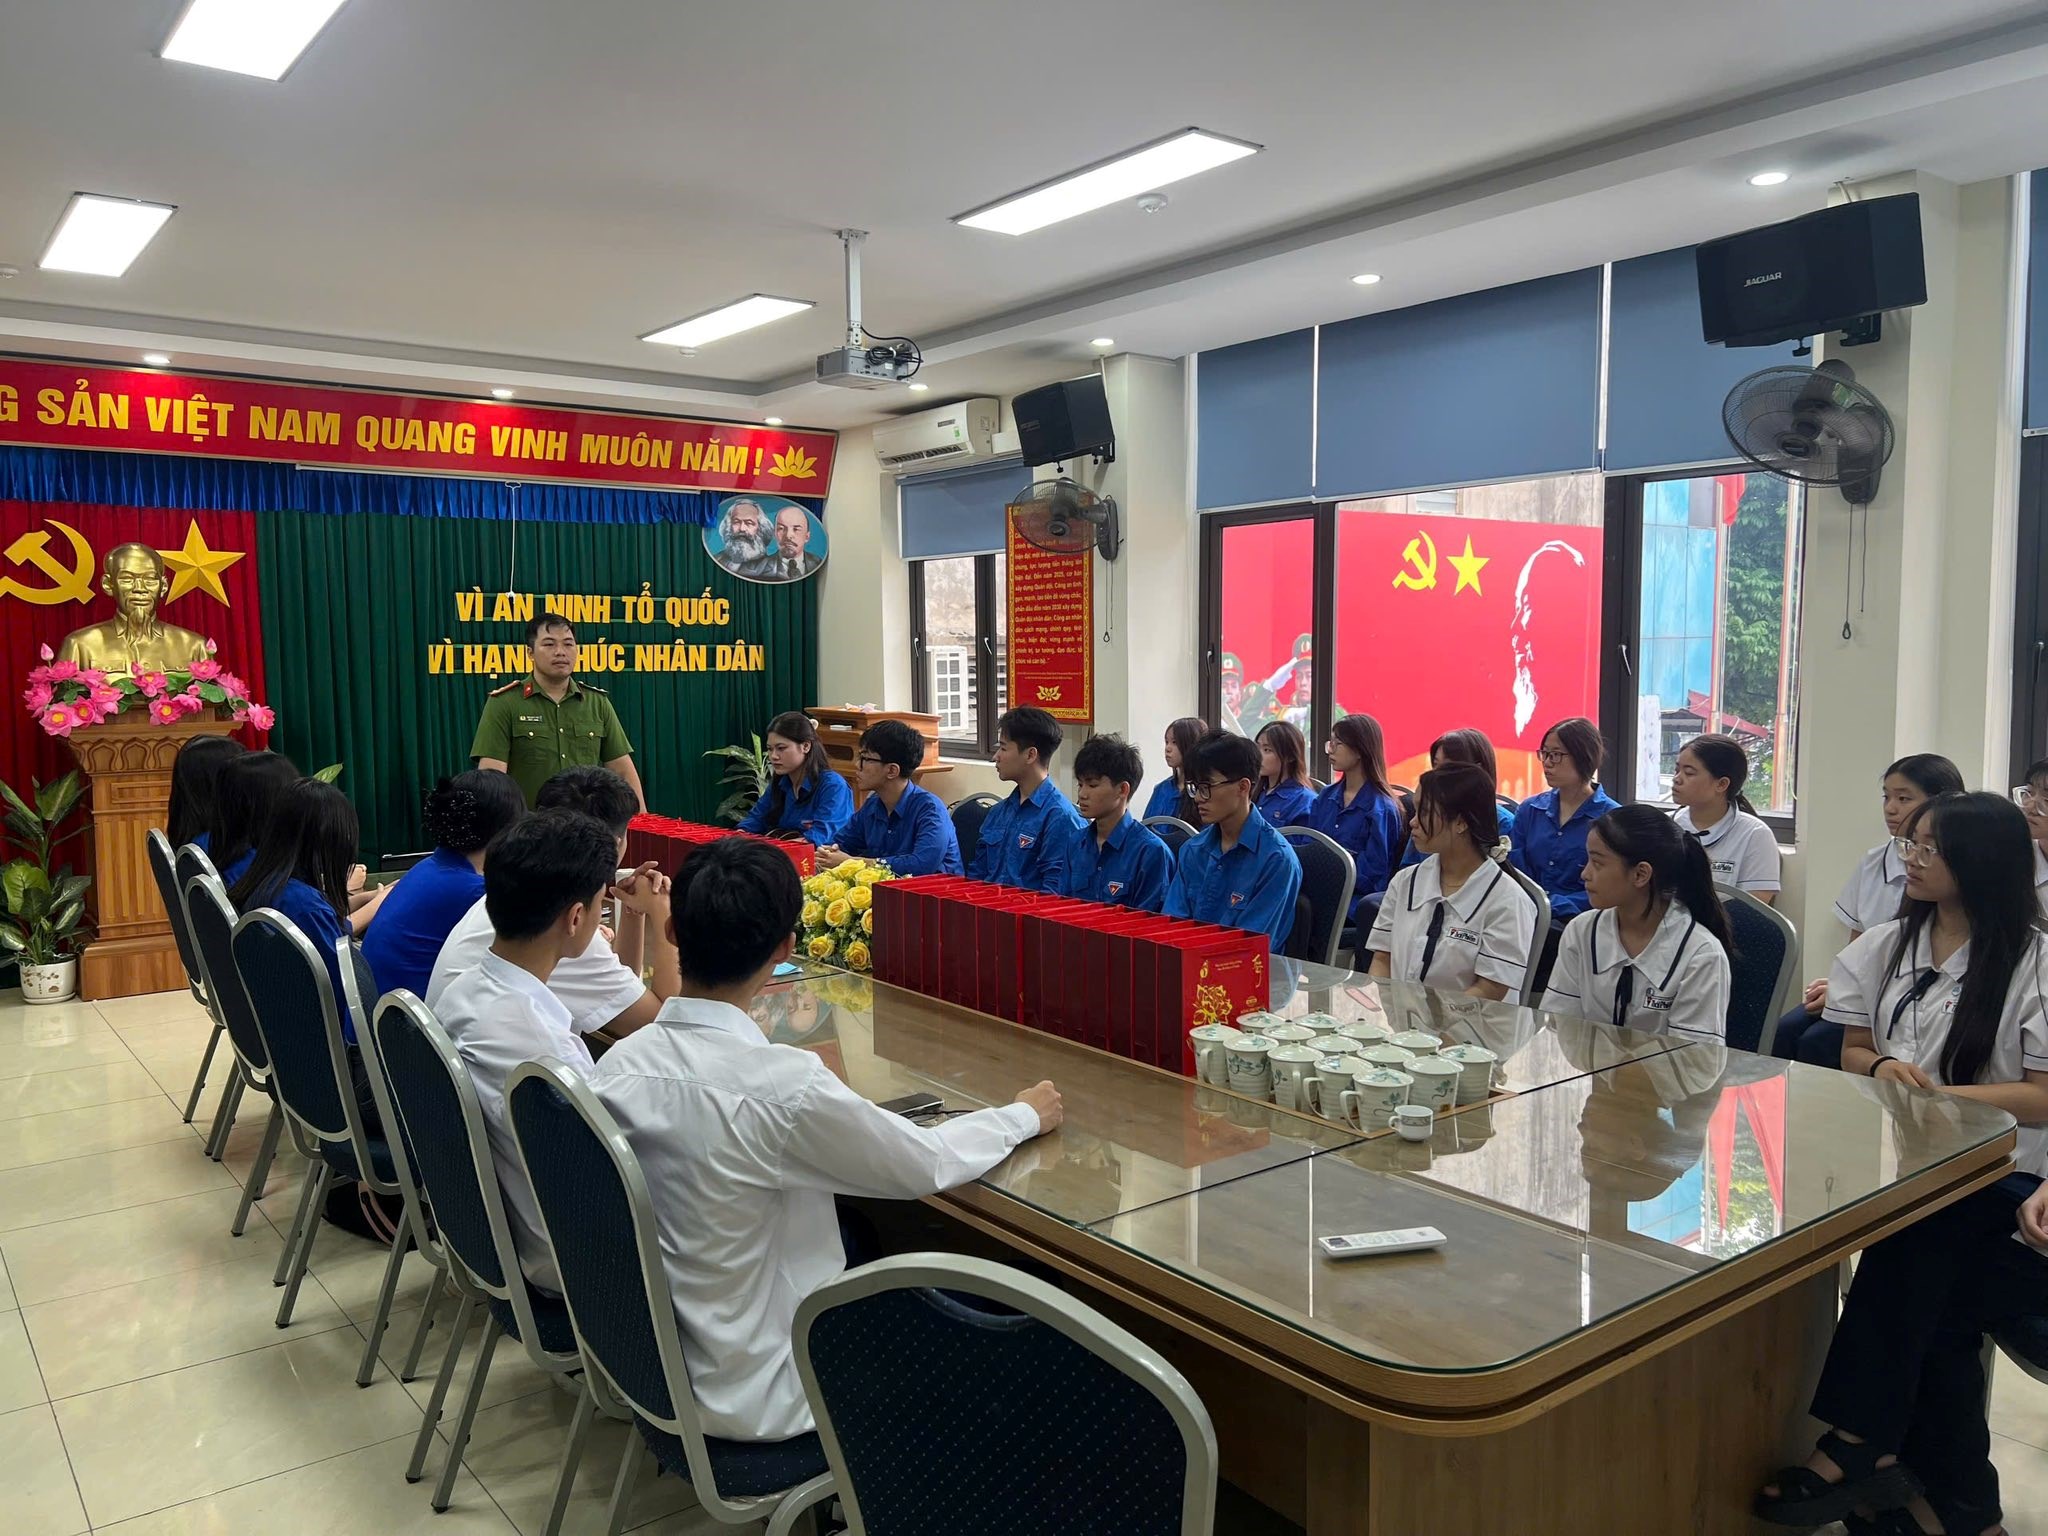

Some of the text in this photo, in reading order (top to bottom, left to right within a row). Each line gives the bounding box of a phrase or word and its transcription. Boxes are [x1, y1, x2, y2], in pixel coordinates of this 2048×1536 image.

[1743, 271, 1782, 288] JAGUAR
[37, 378, 129, 430] SẢN
[145, 393, 234, 442] VIỆT
[249, 405, 341, 446] NAM
[356, 415, 476, 455] QUANG
[490, 425, 568, 461] VINH
[579, 431, 673, 469] MUÔN
[455, 586, 484, 622] VÌ
[492, 592, 534, 622] AN
[621, 581, 654, 624] TỔ
[665, 586, 731, 628] QUỐC
[428, 637, 455, 675] VÌ
[575, 637, 625, 673] HÚC
[634, 638, 705, 672] NHÂN
[715, 639, 765, 672] DÂN
